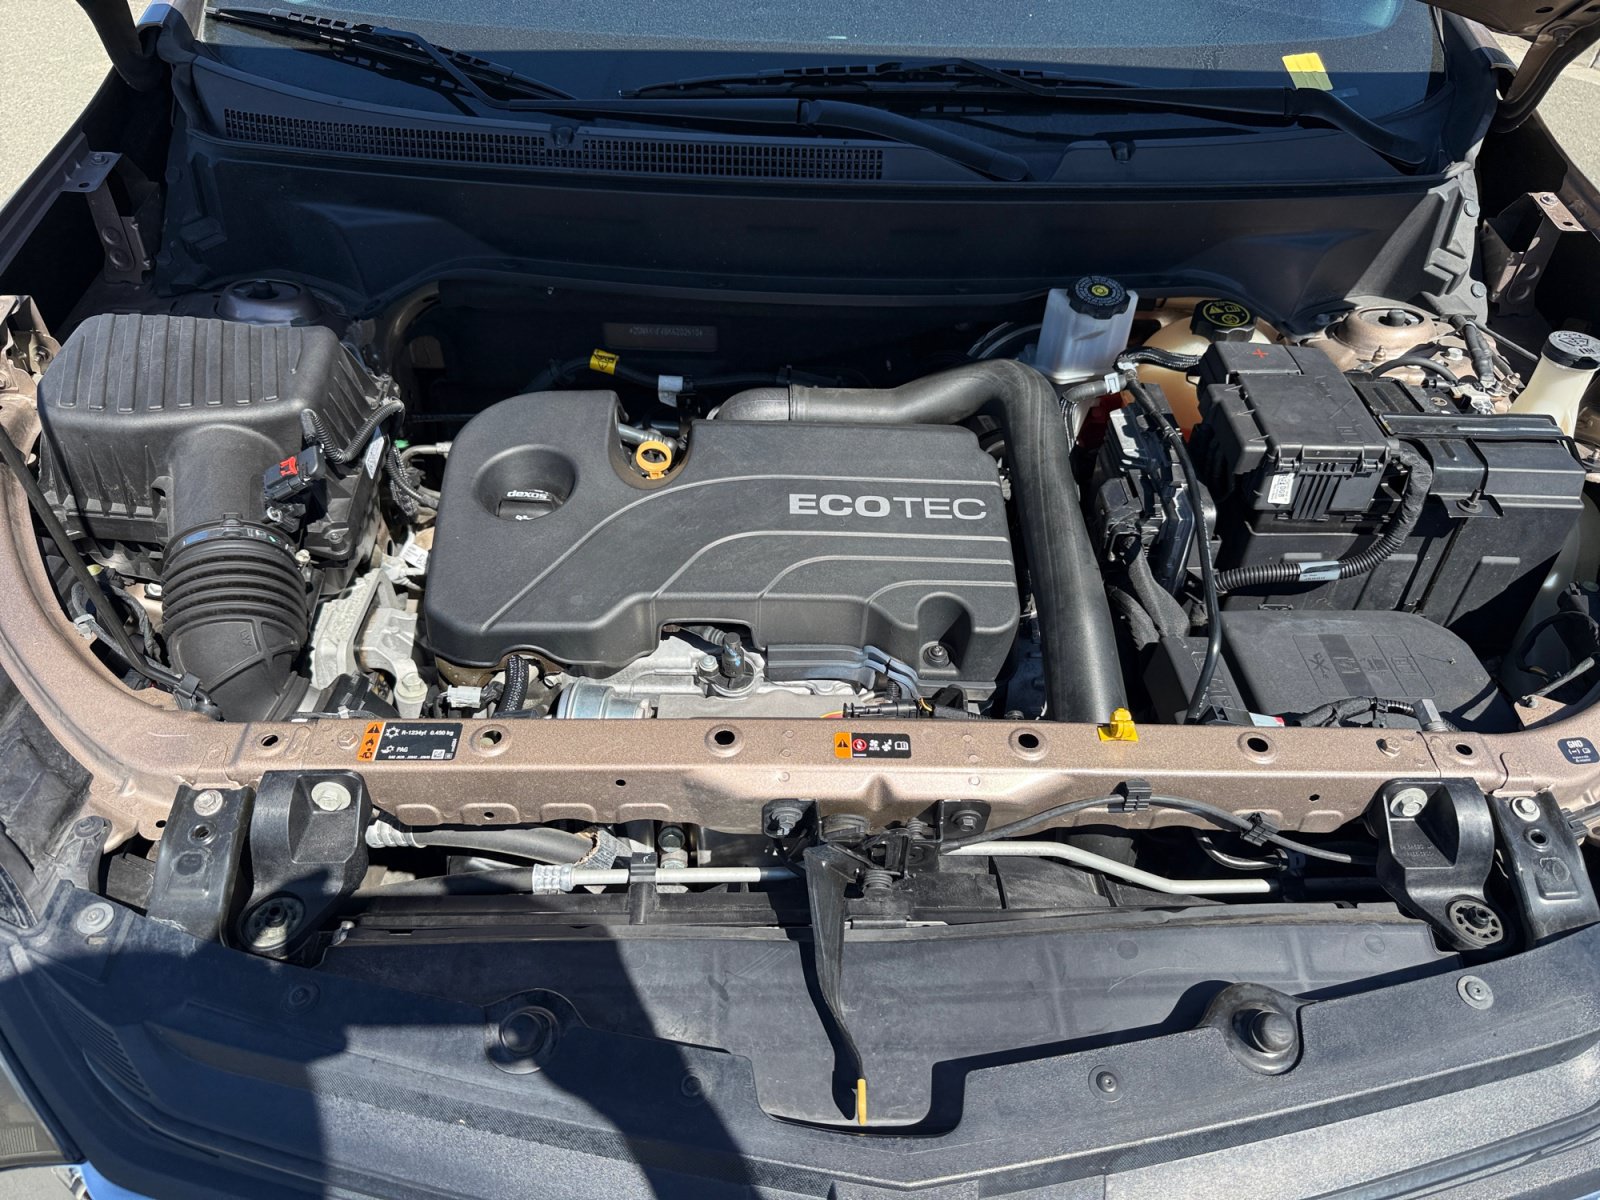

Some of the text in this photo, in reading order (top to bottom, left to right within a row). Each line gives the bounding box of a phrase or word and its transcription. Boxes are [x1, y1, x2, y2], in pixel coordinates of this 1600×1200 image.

[507, 490, 548, 499] dexos
[788, 493, 987, 520] ECOTEC
[1566, 740, 1584, 748] GND
